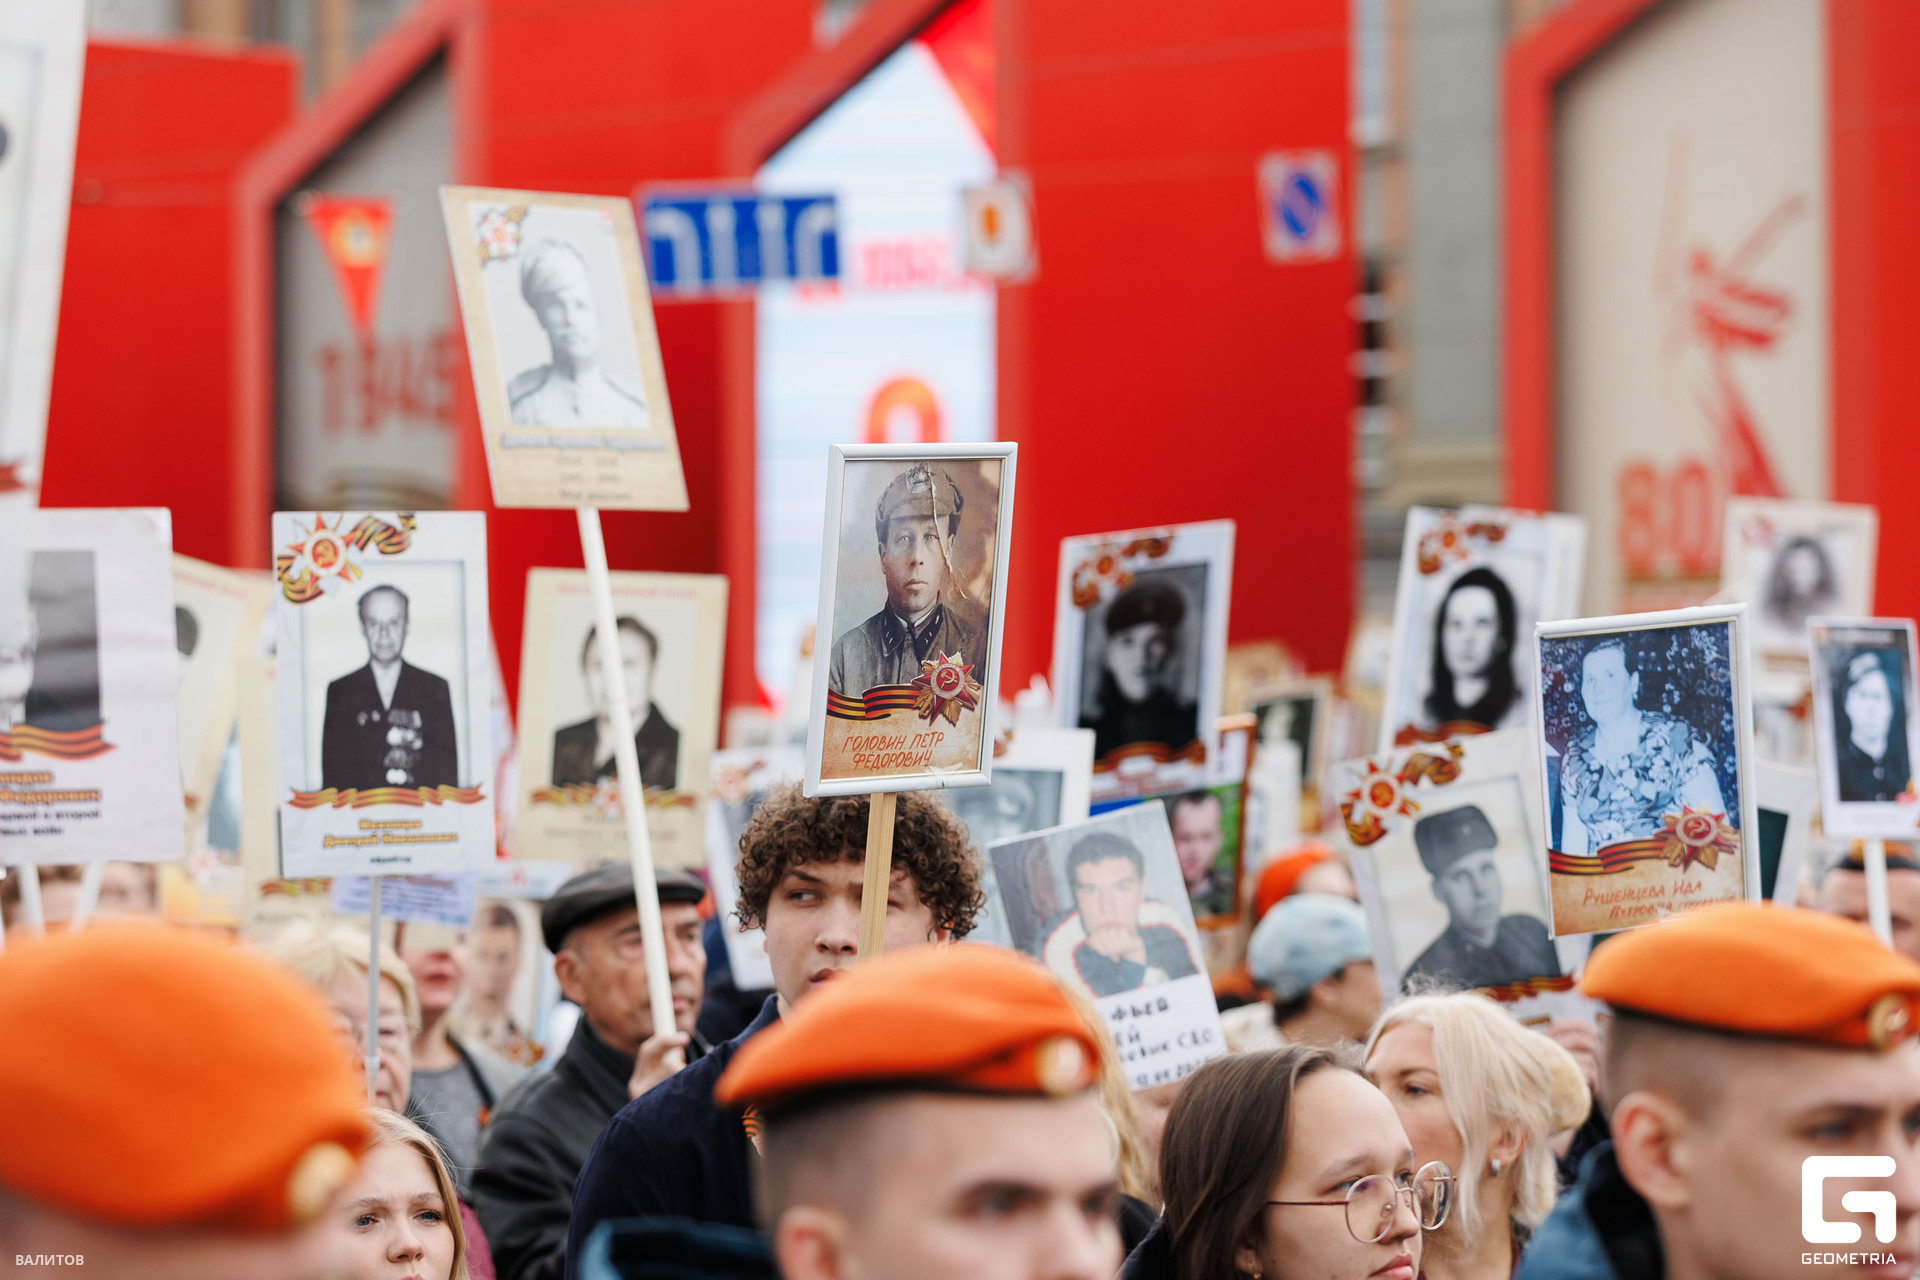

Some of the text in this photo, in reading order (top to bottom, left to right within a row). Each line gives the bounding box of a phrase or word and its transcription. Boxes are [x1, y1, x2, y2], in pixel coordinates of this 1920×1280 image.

[842, 735, 907, 754] ГОЛОВИН
[853, 749, 933, 771] ФЁДОРОВИЧ
[1112, 998, 1168, 1020] ФЬЕВ
[1114, 1025, 1141, 1048] ЕЙ
